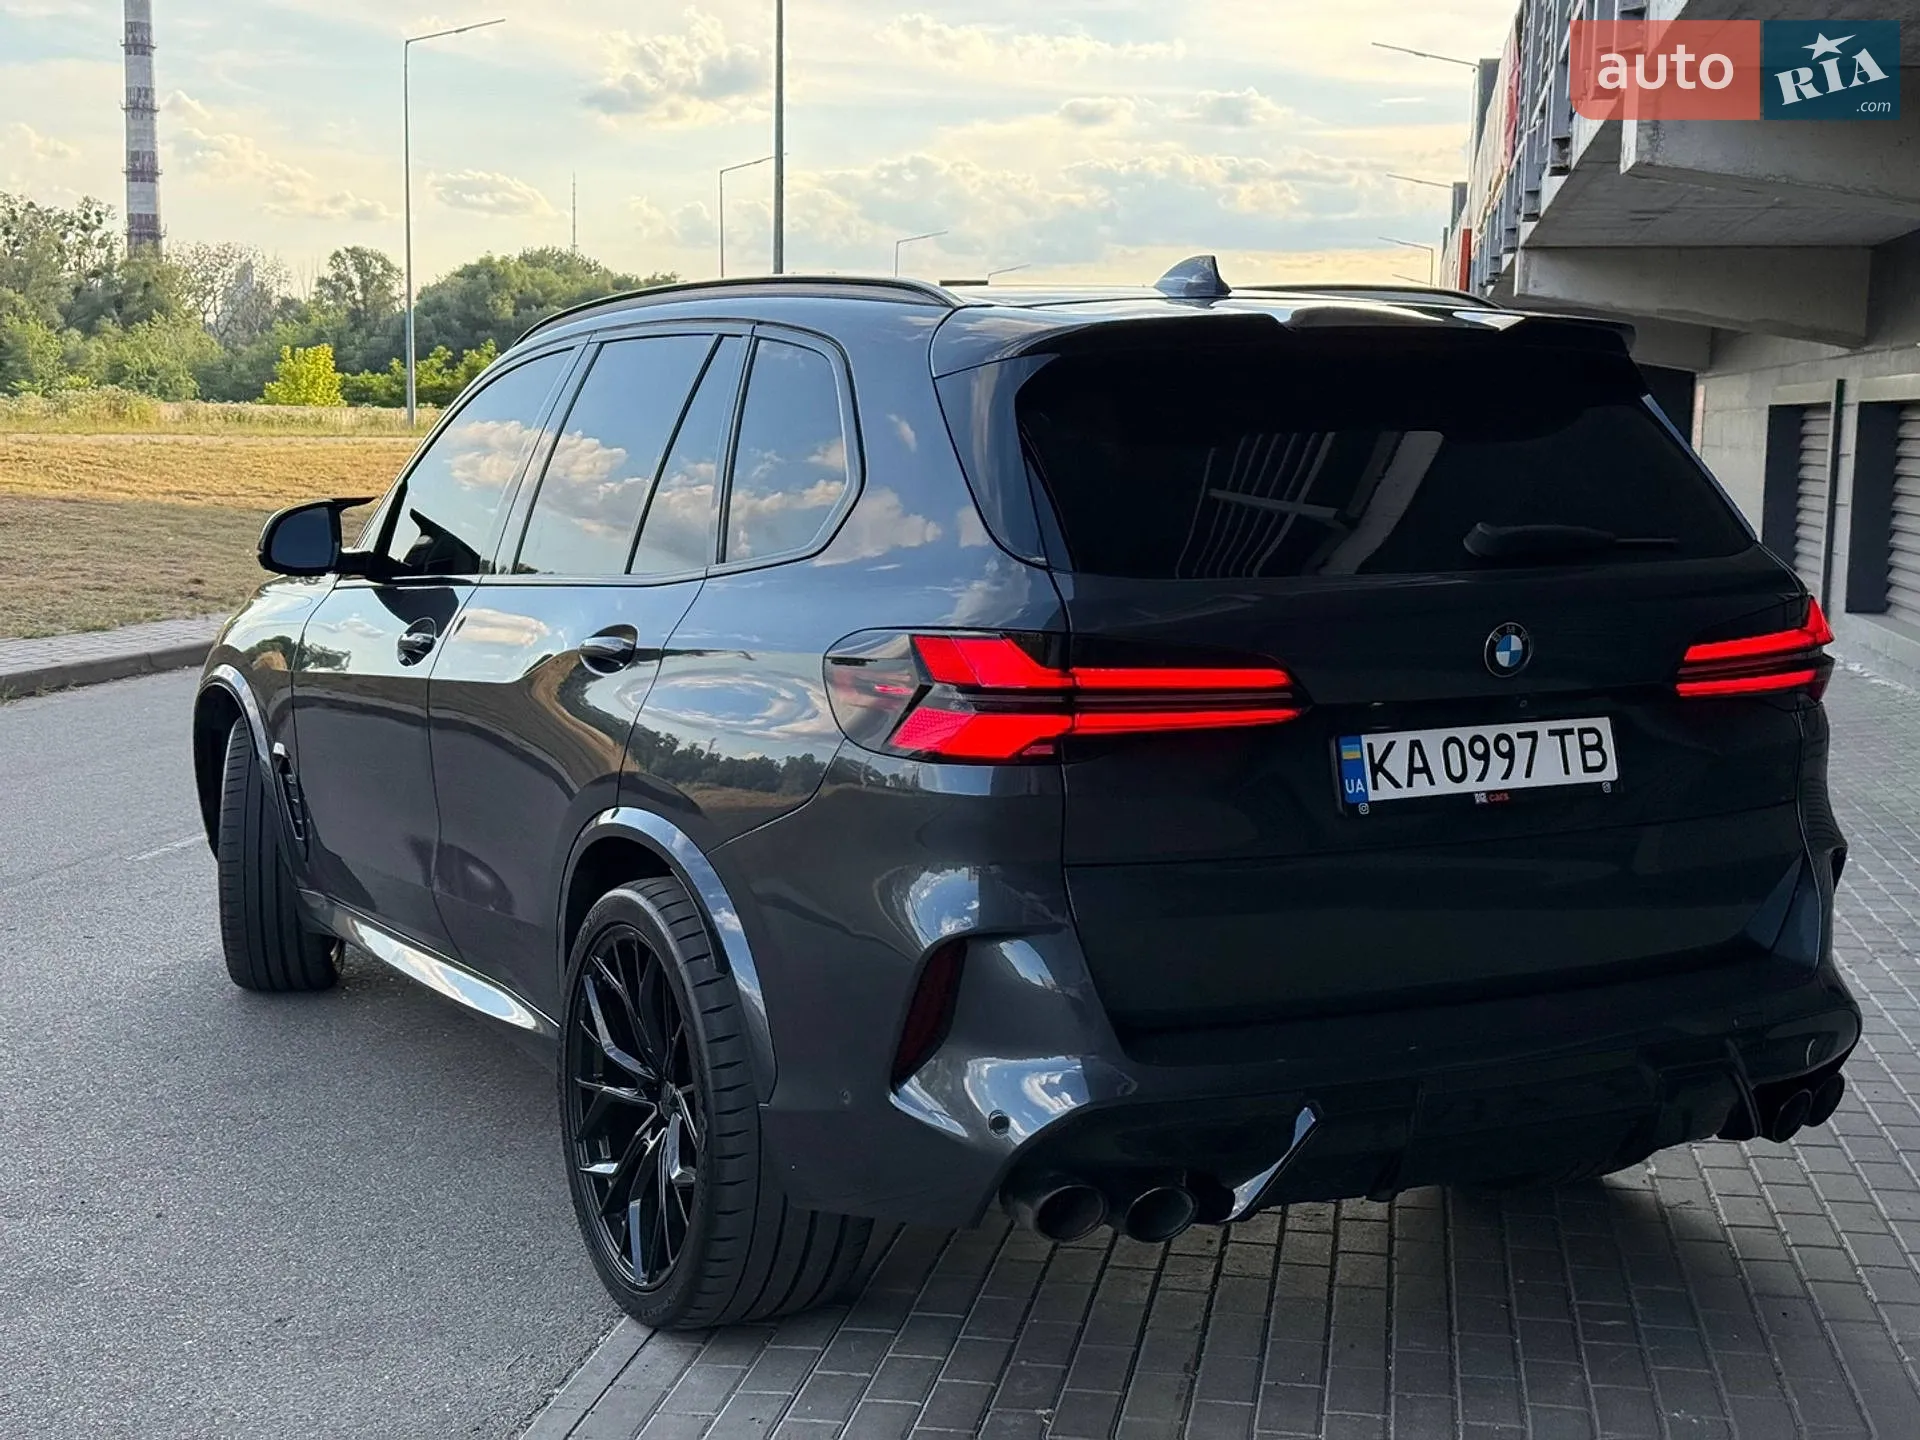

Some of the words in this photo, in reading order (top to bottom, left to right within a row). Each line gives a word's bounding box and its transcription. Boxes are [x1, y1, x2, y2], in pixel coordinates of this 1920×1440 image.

[1366, 738, 1437, 791] KA
[1441, 730, 1539, 784] 0997
[1547, 726, 1608, 776] TB
[1345, 778, 1366, 794] UA
